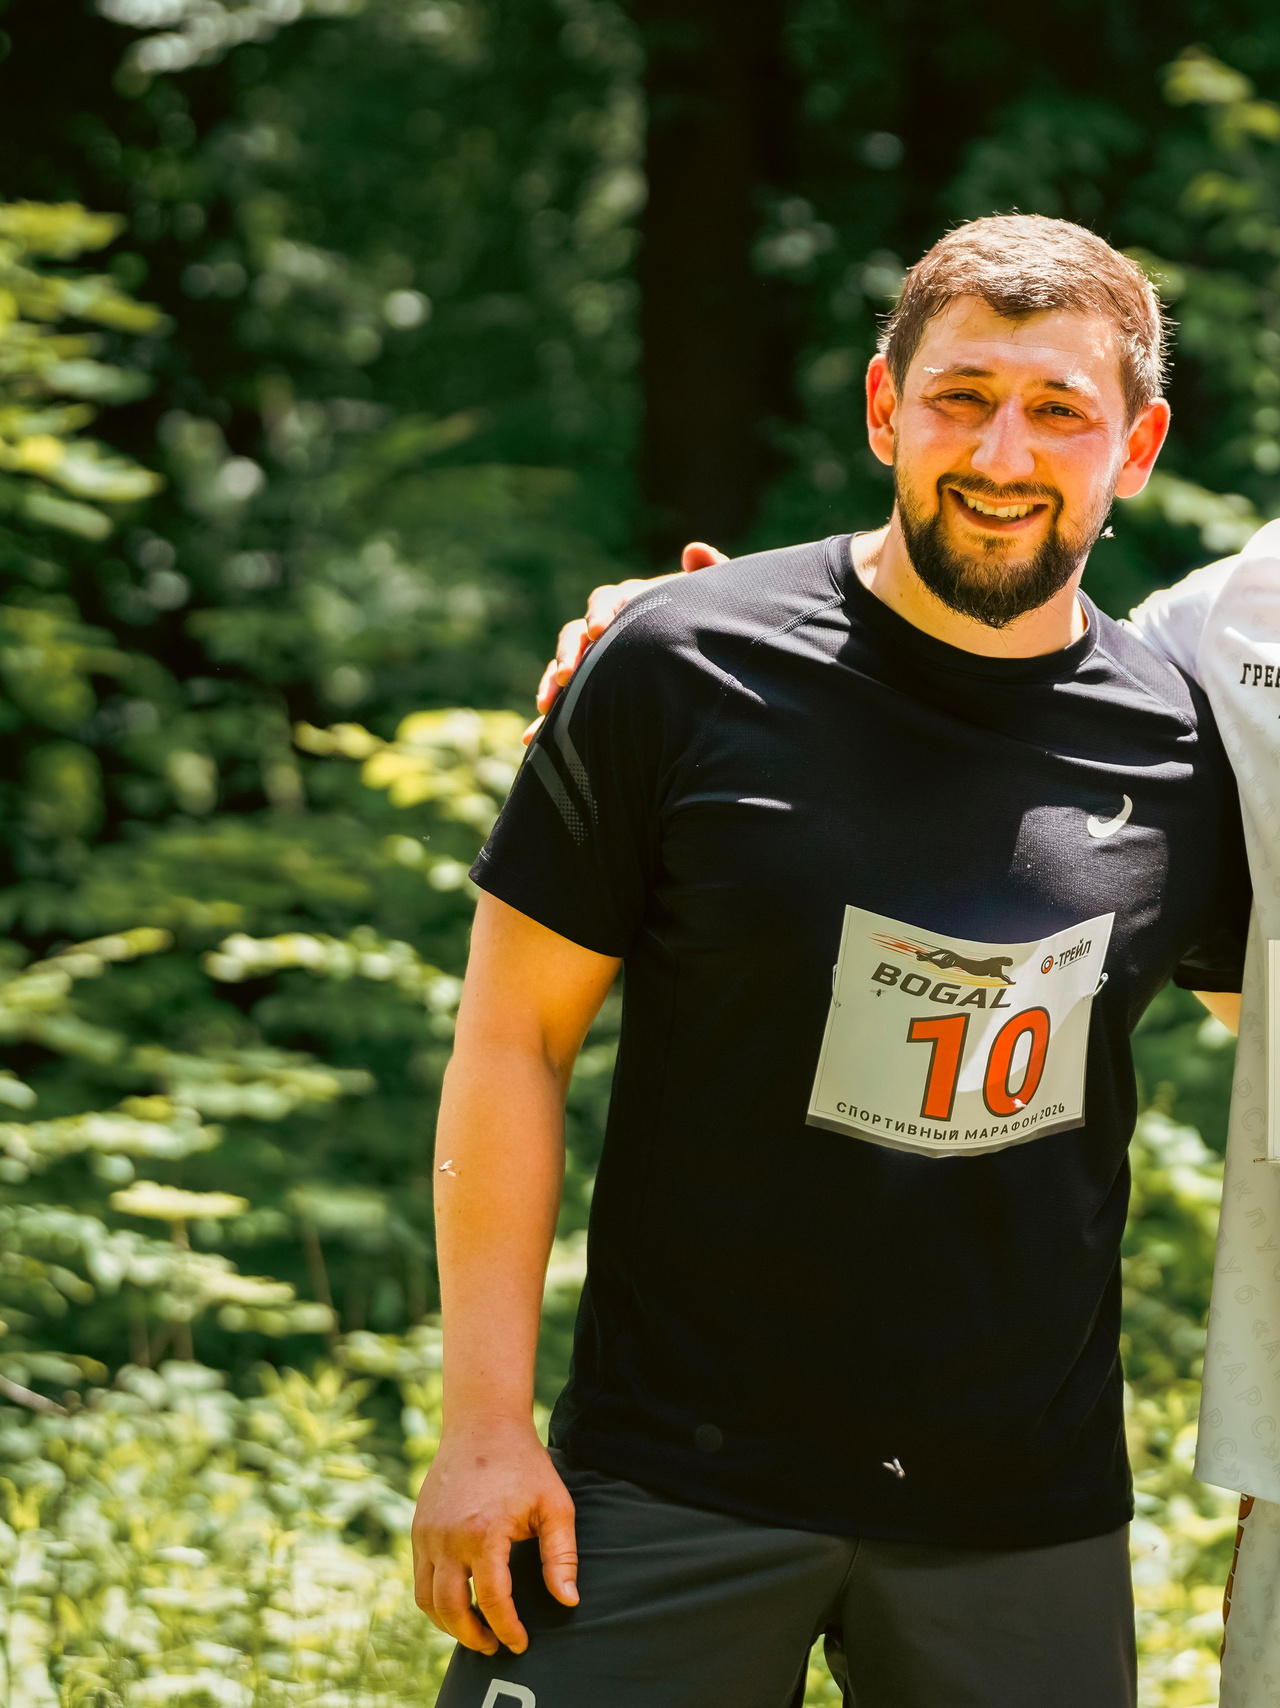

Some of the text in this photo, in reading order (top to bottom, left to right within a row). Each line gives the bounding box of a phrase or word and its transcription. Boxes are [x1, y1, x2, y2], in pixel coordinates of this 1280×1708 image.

[871, 962, 1011, 1009] BOGAL
[906, 1006, 1051, 1122] 10
[836, 1101, 1065, 1141] СПОРТИВНЫЙ МАРАФОН 2026
